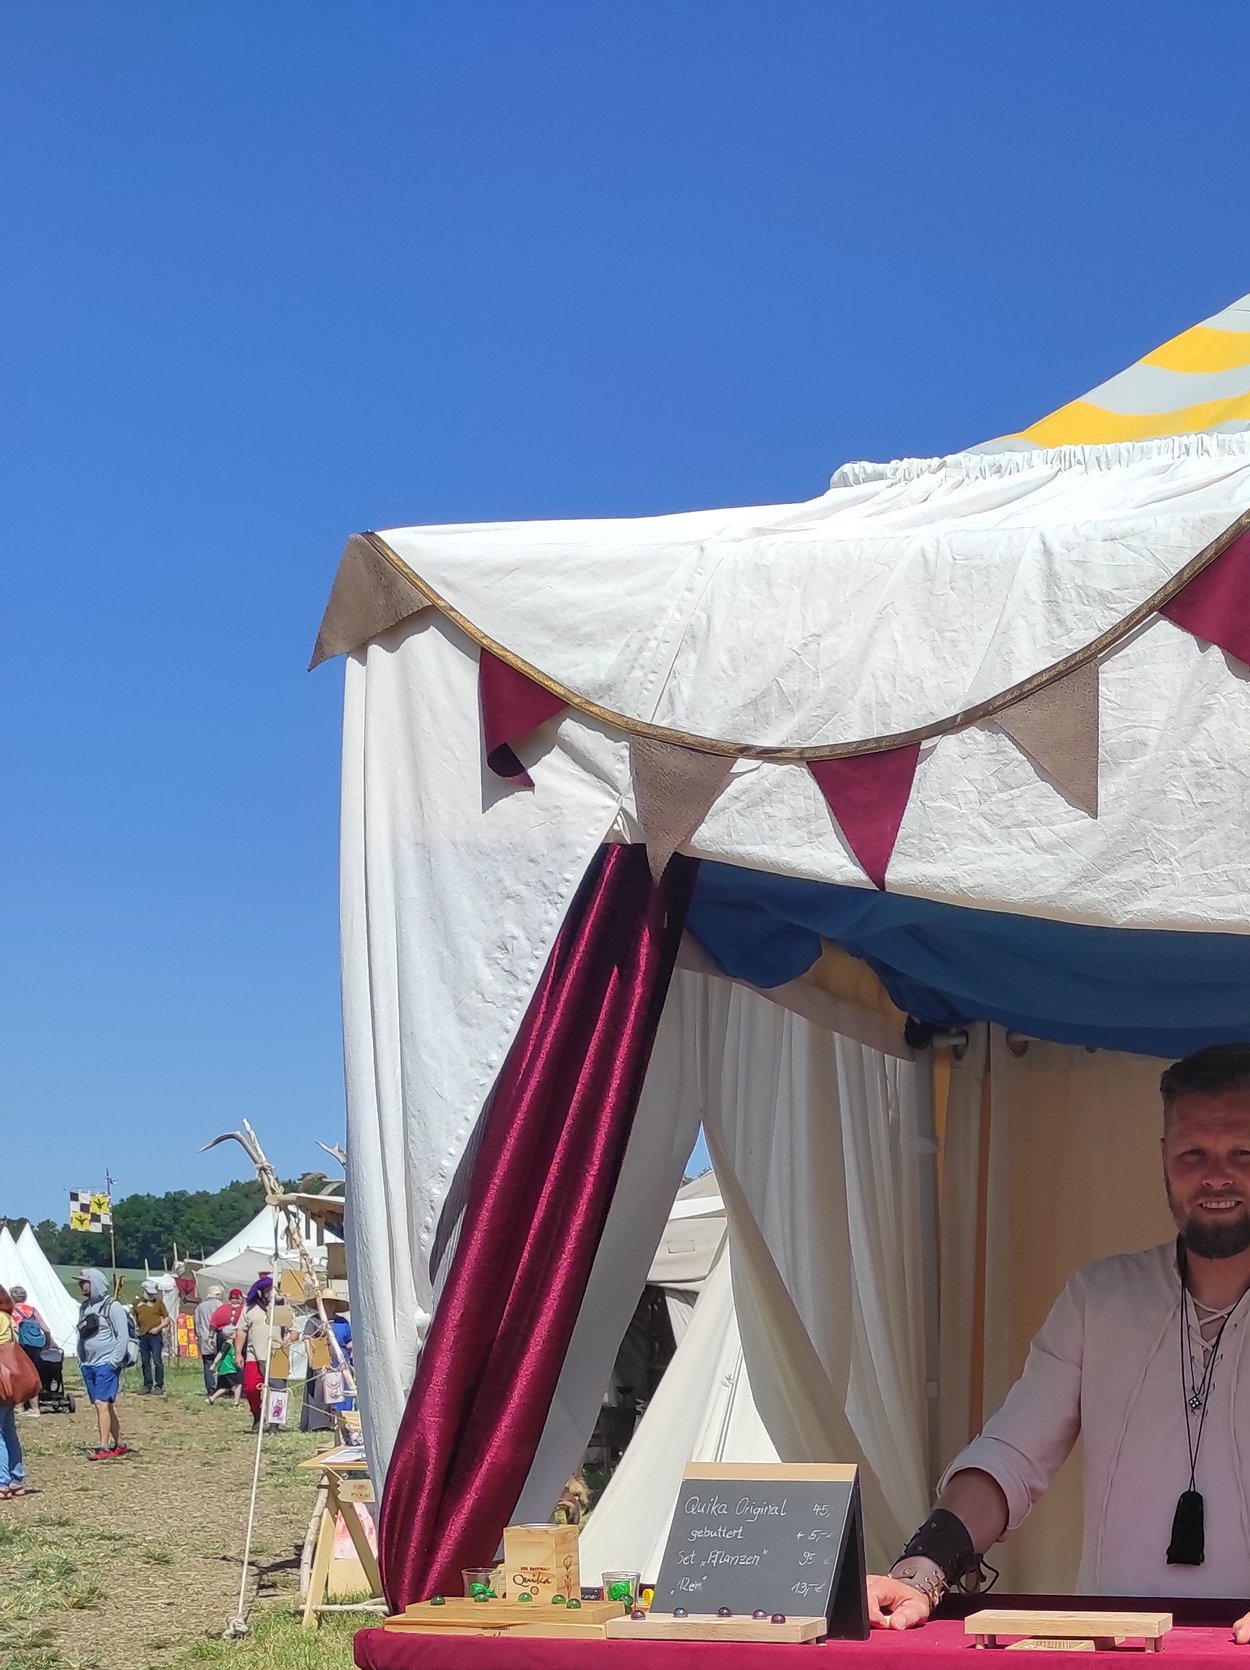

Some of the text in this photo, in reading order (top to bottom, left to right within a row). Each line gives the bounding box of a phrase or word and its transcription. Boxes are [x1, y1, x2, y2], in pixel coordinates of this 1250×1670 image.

[684, 1494, 728, 1517] Quika
[735, 1497, 787, 1523] Original
[687, 1525, 744, 1542] gebuttert
[676, 1550, 697, 1565] Set
[512, 1572, 552, 1588] Quika
